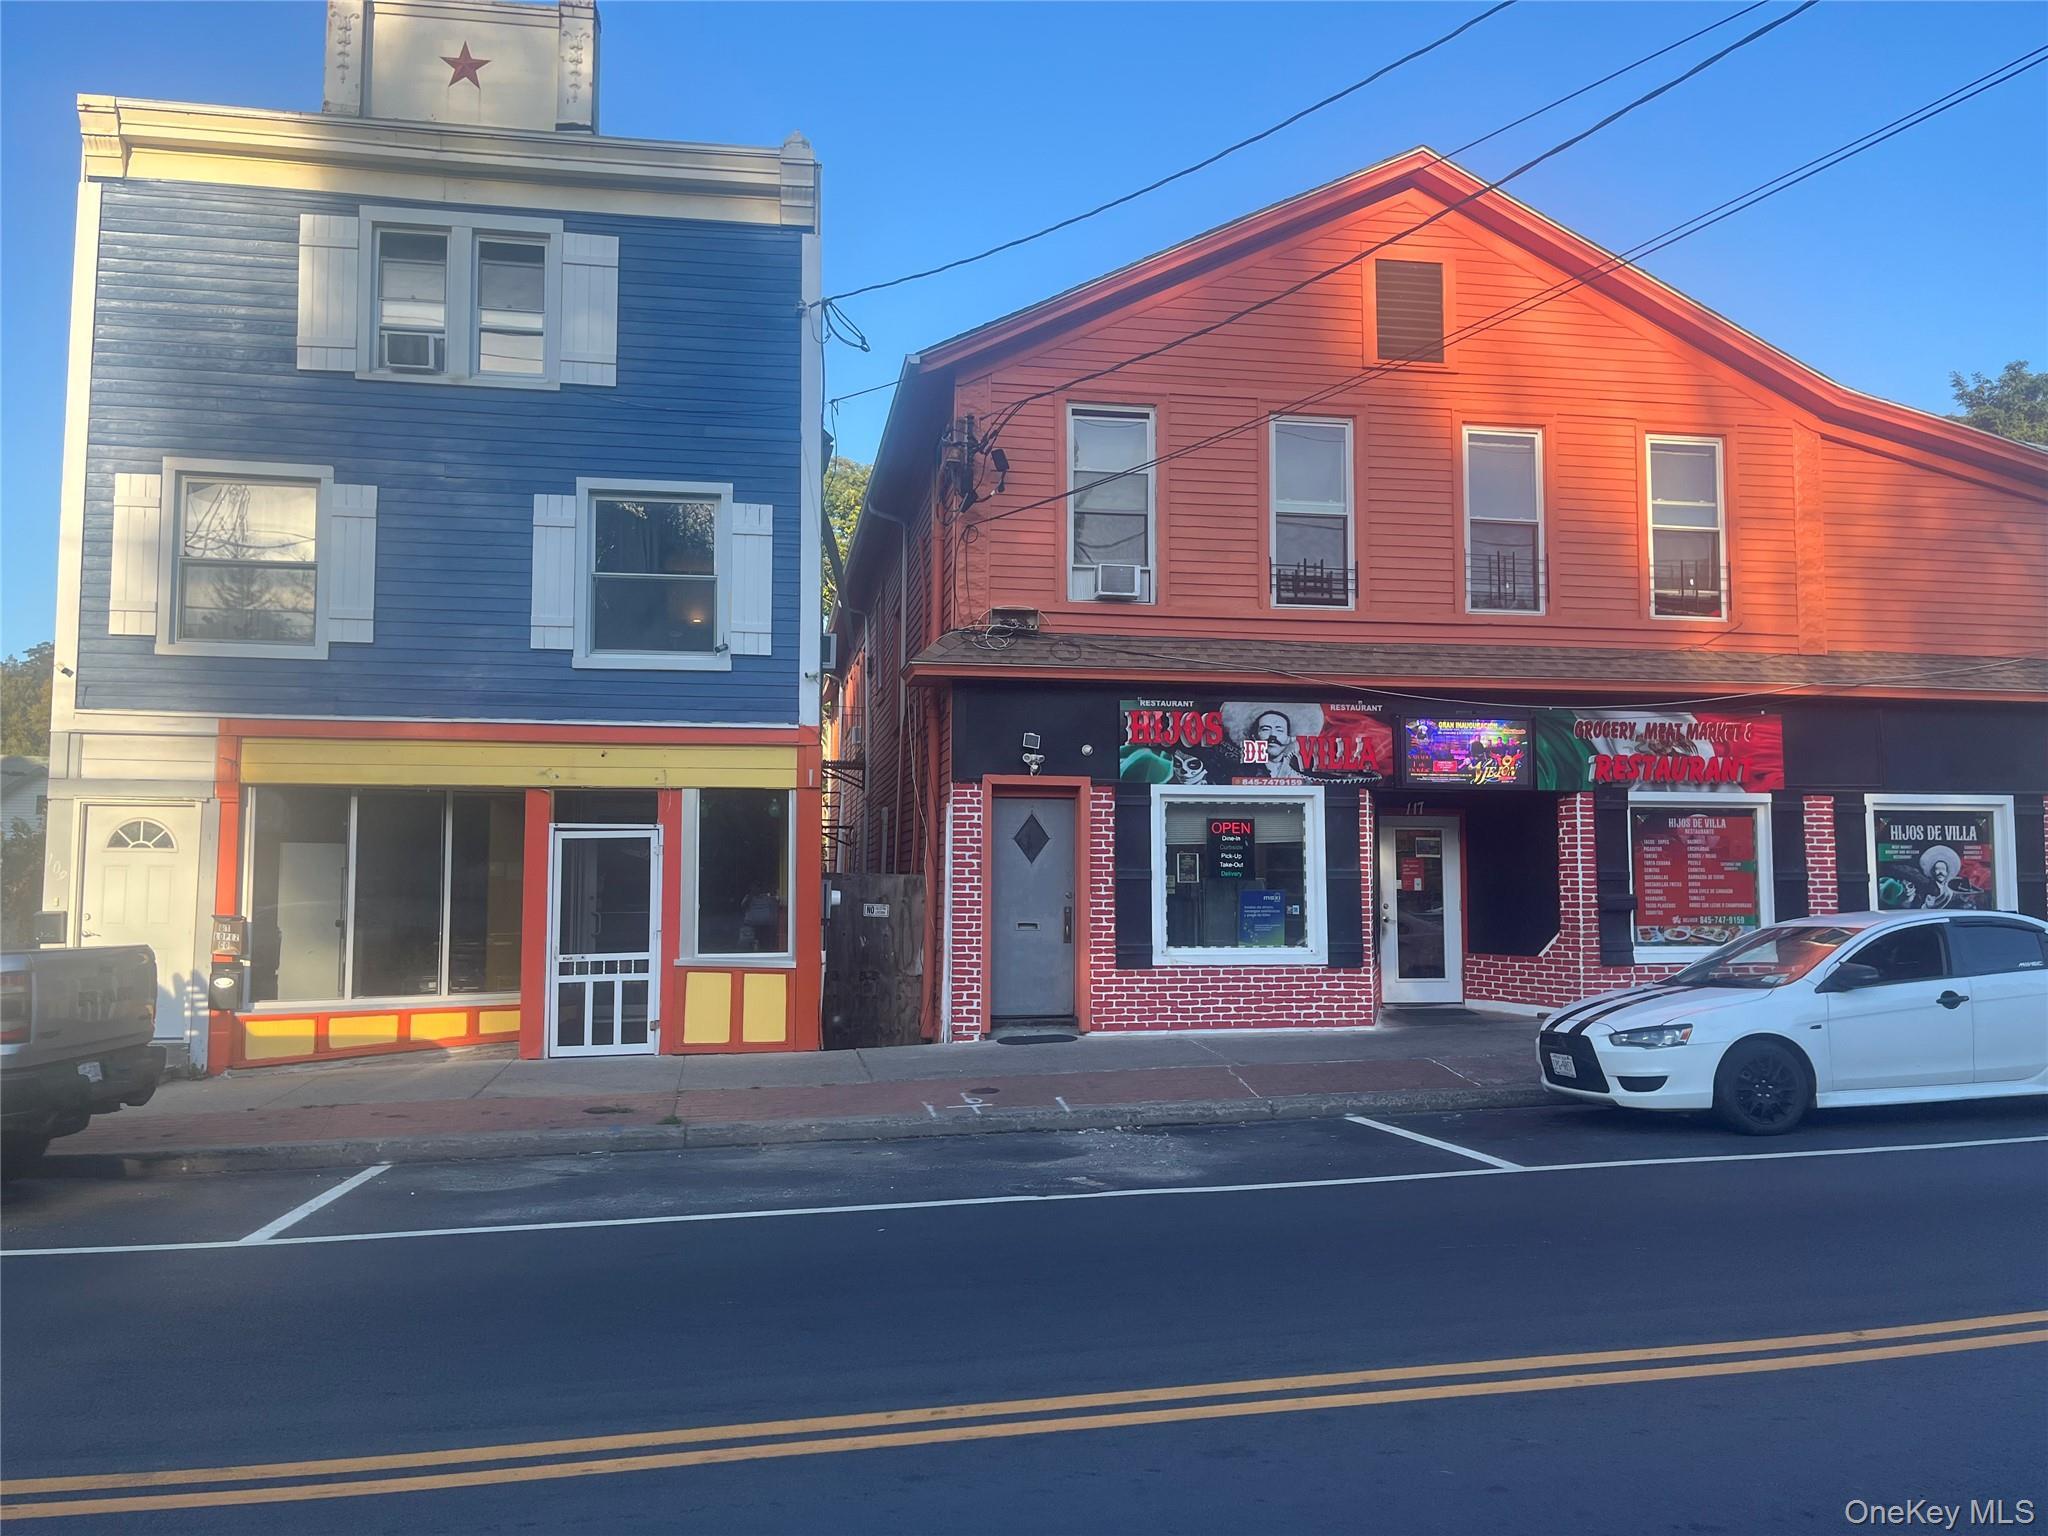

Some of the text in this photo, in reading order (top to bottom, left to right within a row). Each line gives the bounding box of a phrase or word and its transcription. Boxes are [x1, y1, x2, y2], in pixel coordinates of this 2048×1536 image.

[1125, 709, 1380, 771] HIJOS DE VILLA
[1644, 721, 1683, 742] MEAT
[1686, 722, 1742, 743] MARKET
[1588, 753, 1751, 783] RESTAURANT
[1211, 822, 1251, 834] OPEN
[1668, 818, 1726, 828] HIJOS DE VILLA
[1890, 825, 1977, 841] HIJOS DE VILLA
[865, 905, 875, 914] NO
